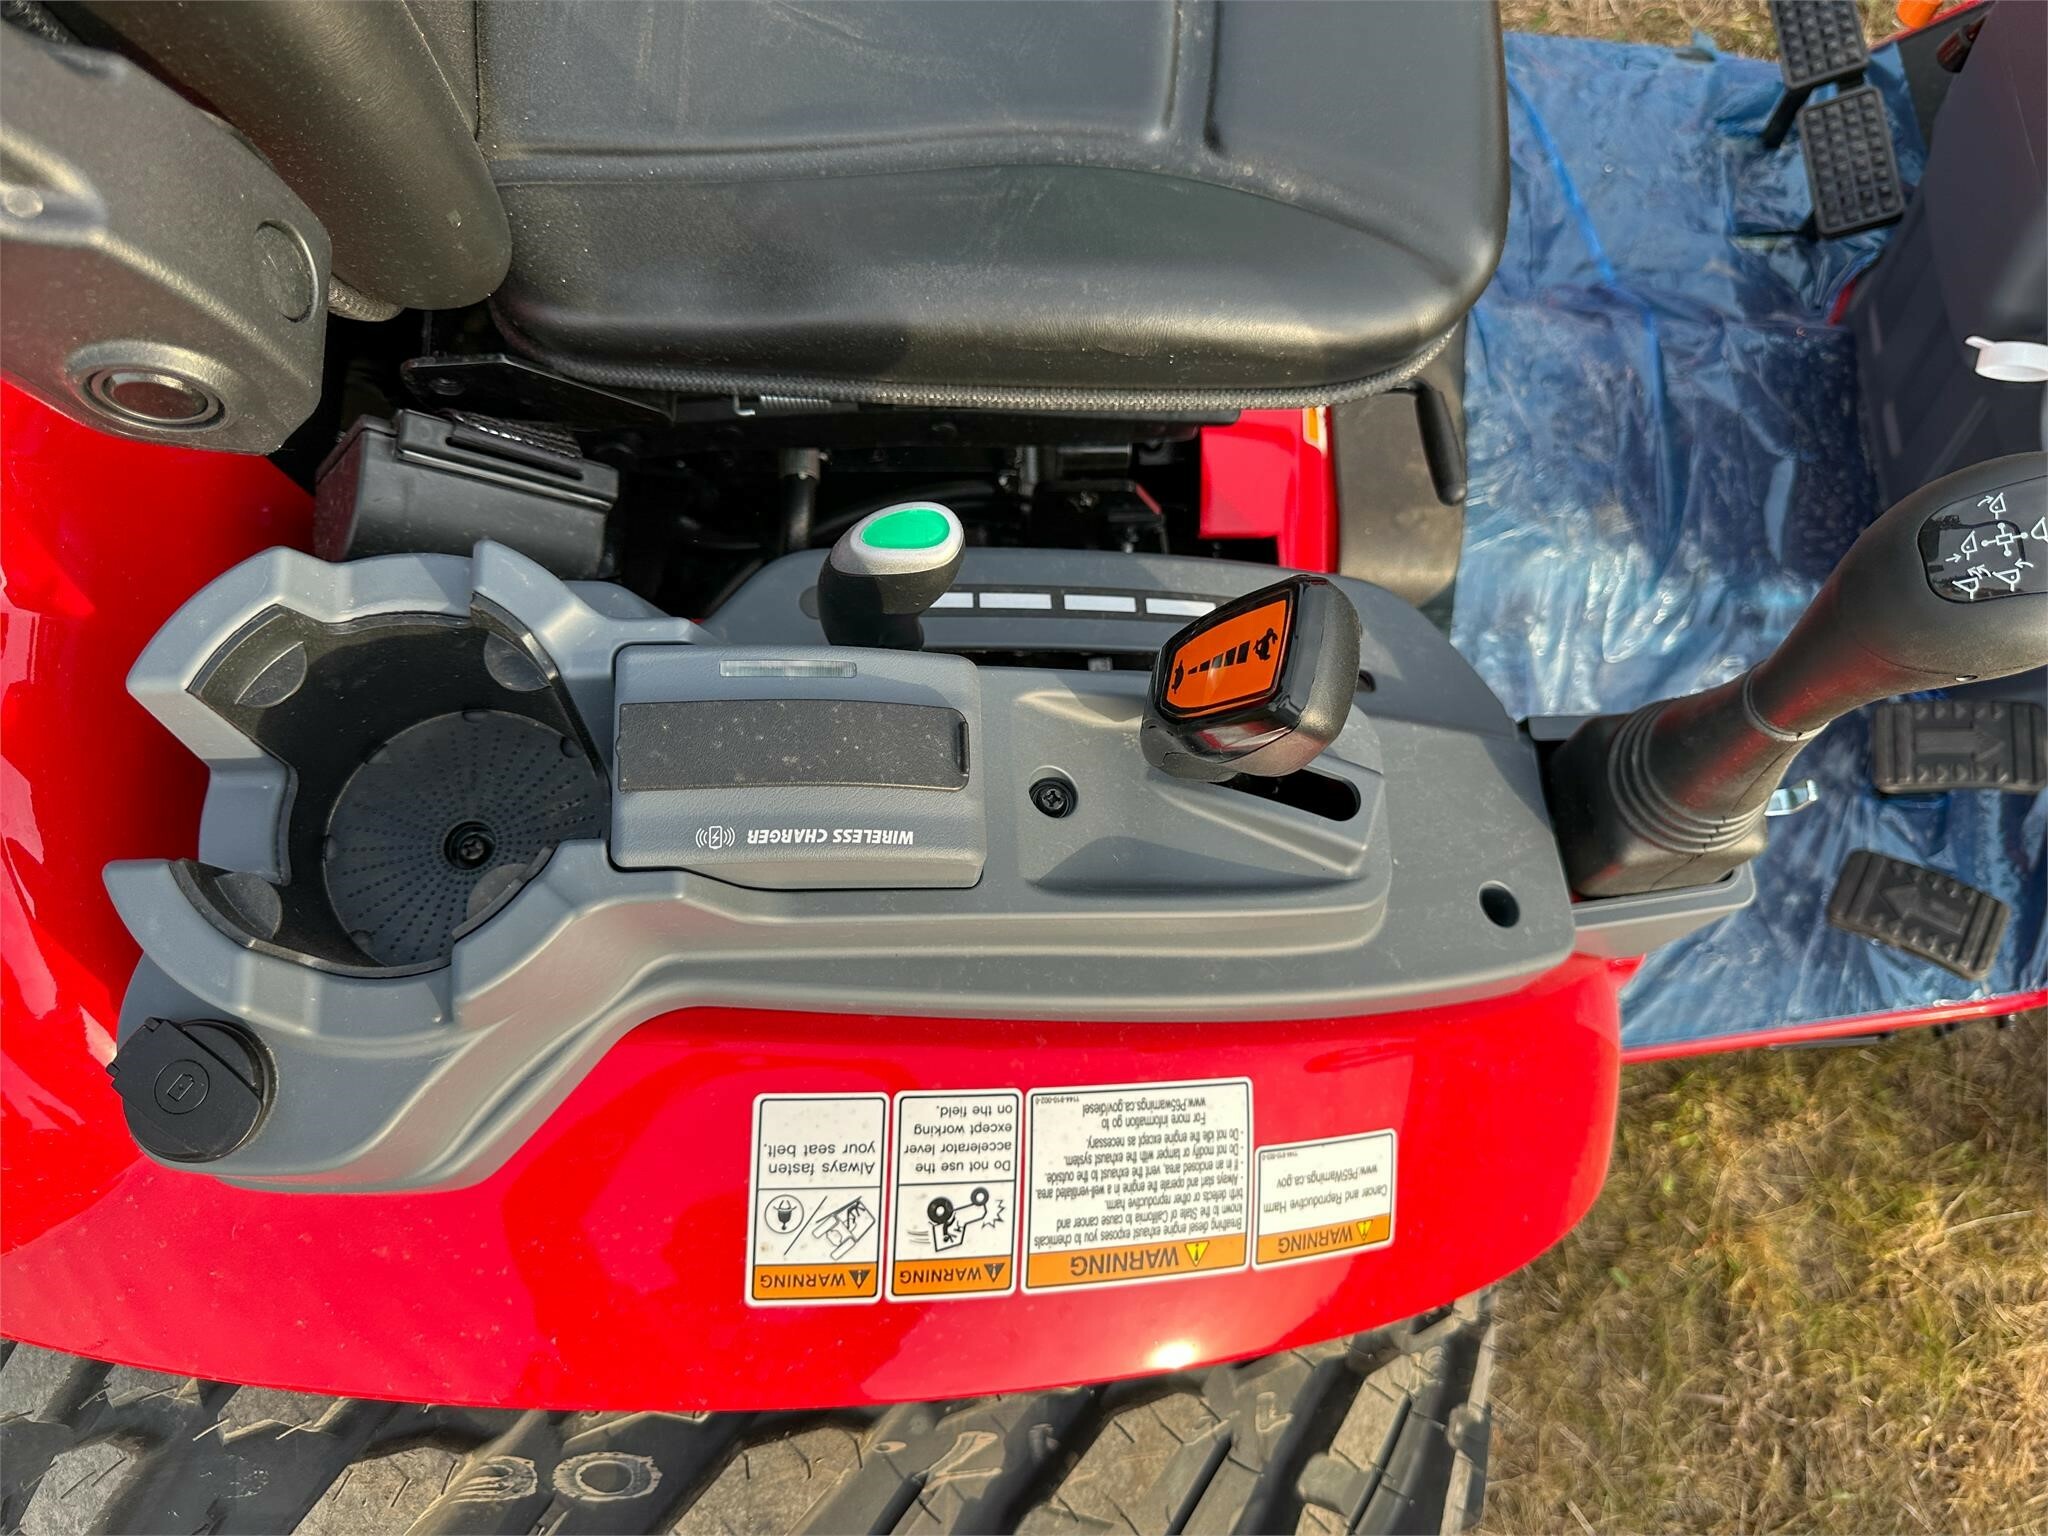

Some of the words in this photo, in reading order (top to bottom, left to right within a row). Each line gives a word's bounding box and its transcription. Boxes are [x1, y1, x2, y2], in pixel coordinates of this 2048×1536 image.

[747, 829, 828, 844] CHARGER
[832, 829, 914, 845] WIRELESS
[936, 1105, 967, 1118] field.
[972, 1105, 992, 1117] the
[997, 1105, 1013, 1114] on
[1082, 1097, 1206, 1118] www.P65warnings.ca.gov/diesel
[1101, 1118, 1109, 1130] to
[1112, 1114, 1123, 1129] go
[1125, 1115, 1168, 1130] information
[1171, 1113, 1191, 1124] more
[1193, 1112, 1206, 1125] For
[914, 1124, 965, 1137] working
[969, 1122, 1012, 1135] except
[1216, 1128, 1227, 1141] not
[1229, 1128, 1238, 1141] Do
[1086, 1135, 1125, 1149] necessary.
[1128, 1136, 1136, 1147] as
[1138, 1132, 1162, 1148] except
[1164, 1130, 1187, 1146] engine
[1190, 1131, 1201, 1144] the
[1202, 1131, 1214, 1143] idle
[764, 1144, 796, 1158] belt.
[804, 1144, 836, 1157] seat
[843, 1141, 875, 1154] your
[904, 1144, 935, 1155] lever
[940, 1141, 1012, 1154] accelerator
[1157, 1146, 1180, 1160] tamper
[1183, 1147, 1190, 1158] or
[1192, 1144, 1215, 1159] modify
[1216, 1144, 1227, 1156] not
[1229, 1143, 1238, 1156] Do
[1064, 1151, 1092, 1168] system.
[1094, 1152, 1123, 1166] exhaust
[1126, 1152, 1137, 1164] the
[1140, 1150, 1154, 1163] with
[769, 1163, 814, 1176] fasten
[822, 1160, 875, 1175] Always
[915, 1163, 935, 1174] the
[941, 1162, 964, 1172] use
[969, 1161, 989, 1172] not
[994, 1160, 1011, 1172] Do
[1163, 1163, 1181, 1174] area,
[1183, 1161, 1213, 1175] enclosed
[1215, 1159, 1224, 1170] an
[1226, 1159, 1232, 1171] in
[1077, 1170, 1089, 1183] the
[1091, 1170, 1098, 1182] to
[1101, 1167, 1129, 1181] exhaust
[1132, 1166, 1143, 1179] the
[1145, 1165, 1160, 1178] vent
[1276, 1164, 1378, 1189] www.P65Warnings.ca.gov
[1044, 1171, 1074, 1186] outside.
[1160, 1176, 1185, 1191] operate
[1187, 1177, 1199, 1190] and
[1201, 1176, 1215, 1188] start
[1217, 1171, 1238, 1186] Always
[1056, 1185, 1104, 1201] well-ventilated
[1107, 1184, 1112, 1194] a
[1114, 1184, 1120, 1196] in
[1123, 1179, 1145, 1196] engine
[1147, 1181, 1158, 1193] the
[1362, 1184, 1388, 1198] Cancer
[1036, 1189, 1053, 1200] area.
[1128, 1192, 1171, 1209] reproductive
[1173, 1193, 1191, 1205] other
[1193, 1192, 1200, 1202] or
[1203, 1189, 1227, 1203] defects
[1229, 1188, 1243, 1201] birth
[1290, 1192, 1342, 1210] Reproductive
[1345, 1189, 1359, 1202] and
[1104, 1199, 1125, 1211] harm.
[1213, 1205, 1219, 1216] to
[1222, 1203, 1242, 1214] known
[1263, 1201, 1286, 1215] Harm
[1135, 1210, 1168, 1225] California
[1170, 1209, 1177, 1223] of
[1180, 1207, 1198, 1220] State
[1200, 1206, 1210, 1218] the
[1056, 1218, 1071, 1232] and
[1073, 1216, 1099, 1229] cancer
[1101, 1214, 1123, 1226] cause
[1125, 1213, 1132, 1225] to
[1211, 1217, 1242, 1231] Breathing
[1101, 1227, 1130, 1240] exposes
[1133, 1226, 1161, 1240] exhaust
[1163, 1221, 1186, 1236] engine
[1189, 1221, 1208, 1235] diesel
[1034, 1234, 1072, 1249] chemicals
[1074, 1234, 1081, 1245] to
[1084, 1228, 1098, 1243] you
[1278, 1225, 1353, 1253] WARNING
[1070, 1247, 1179, 1277] WARNING
[760, 1273, 846, 1289] WARNING
[900, 1267, 981, 1284] WARNING
